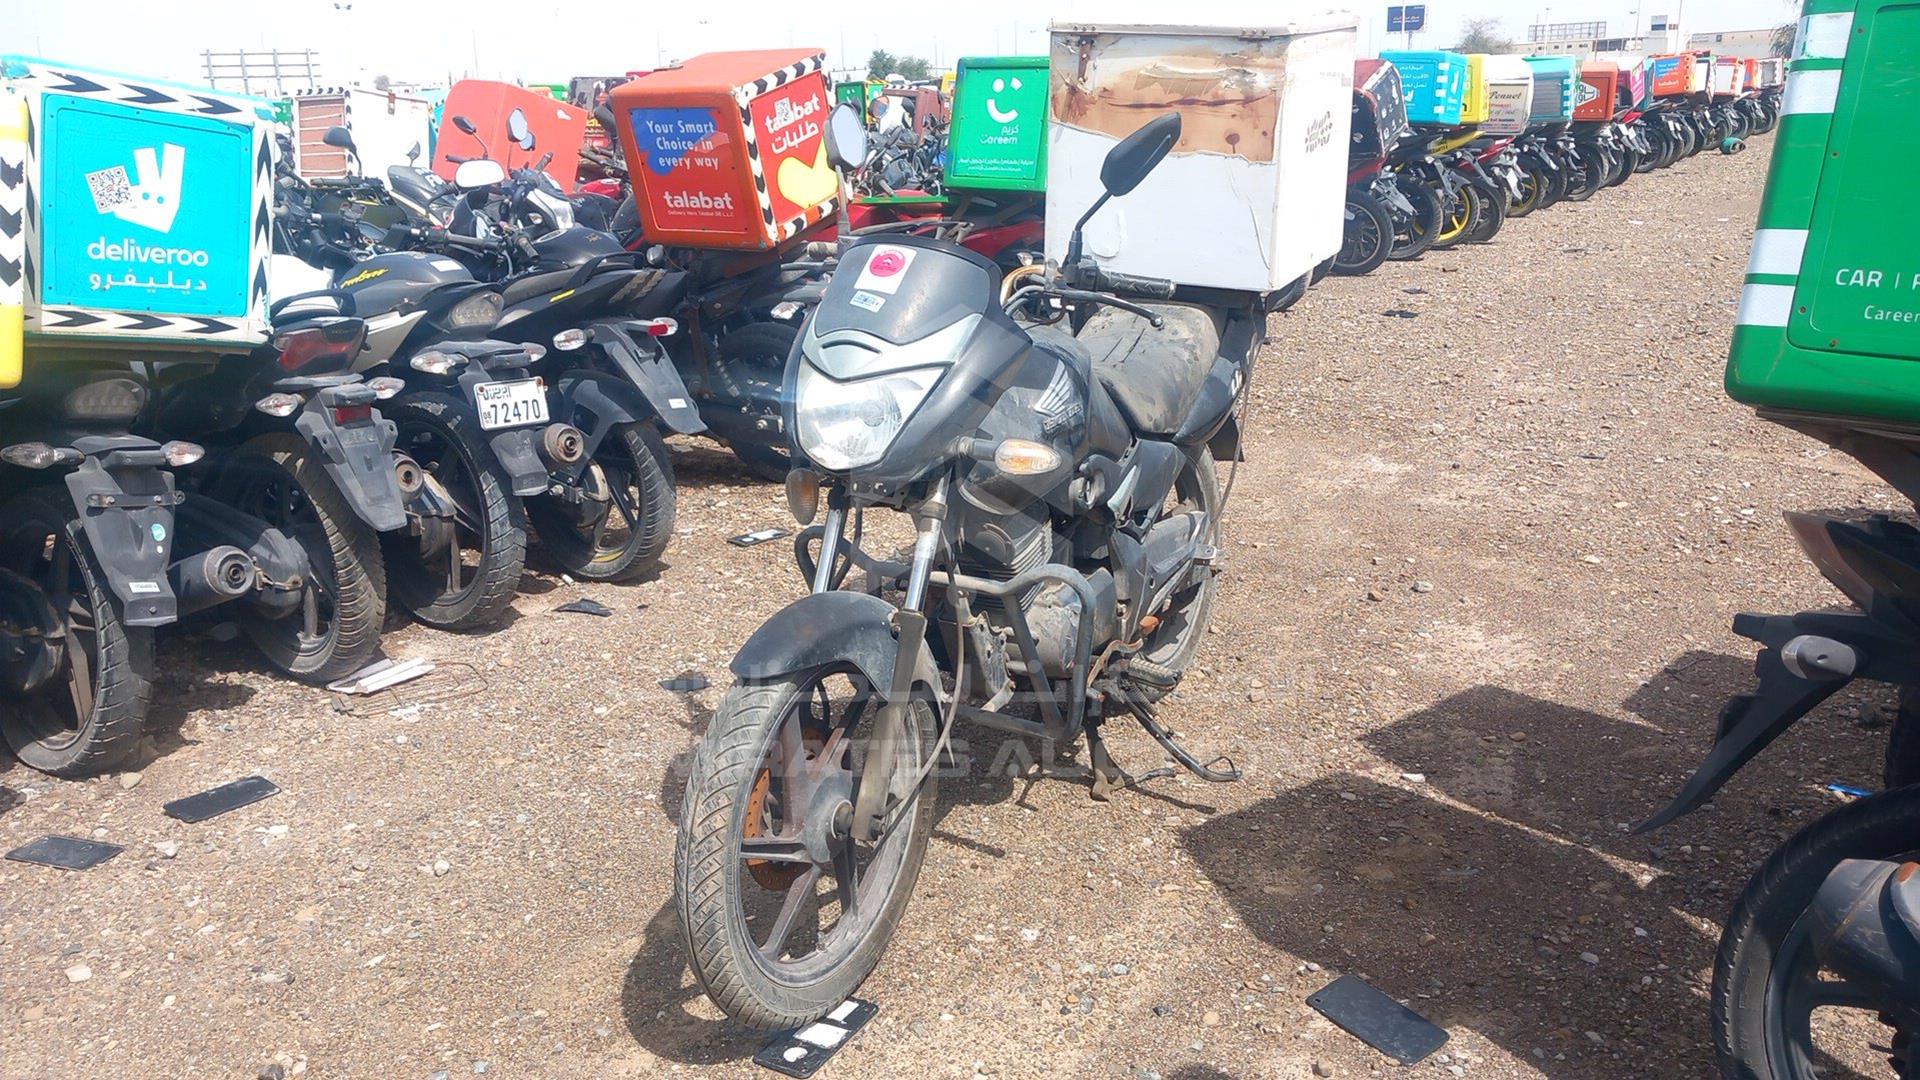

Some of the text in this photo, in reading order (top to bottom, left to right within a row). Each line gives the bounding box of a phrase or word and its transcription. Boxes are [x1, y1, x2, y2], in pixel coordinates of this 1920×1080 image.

[647, 120, 714, 134] Your Smart
[771, 120, 819, 154] طلبات
[1001, 125, 1019, 136] كريم
[656, 137, 713, 152] Choice, in
[980, 133, 1018, 145] Careem
[659, 158, 719, 170] every way
[663, 190, 734, 210] talabat
[87, 236, 209, 267] deliveroo
[89, 268, 207, 295] ديليفرو
[1836, 268, 1883, 288] CAR
[490, 399, 540, 424] 72470
